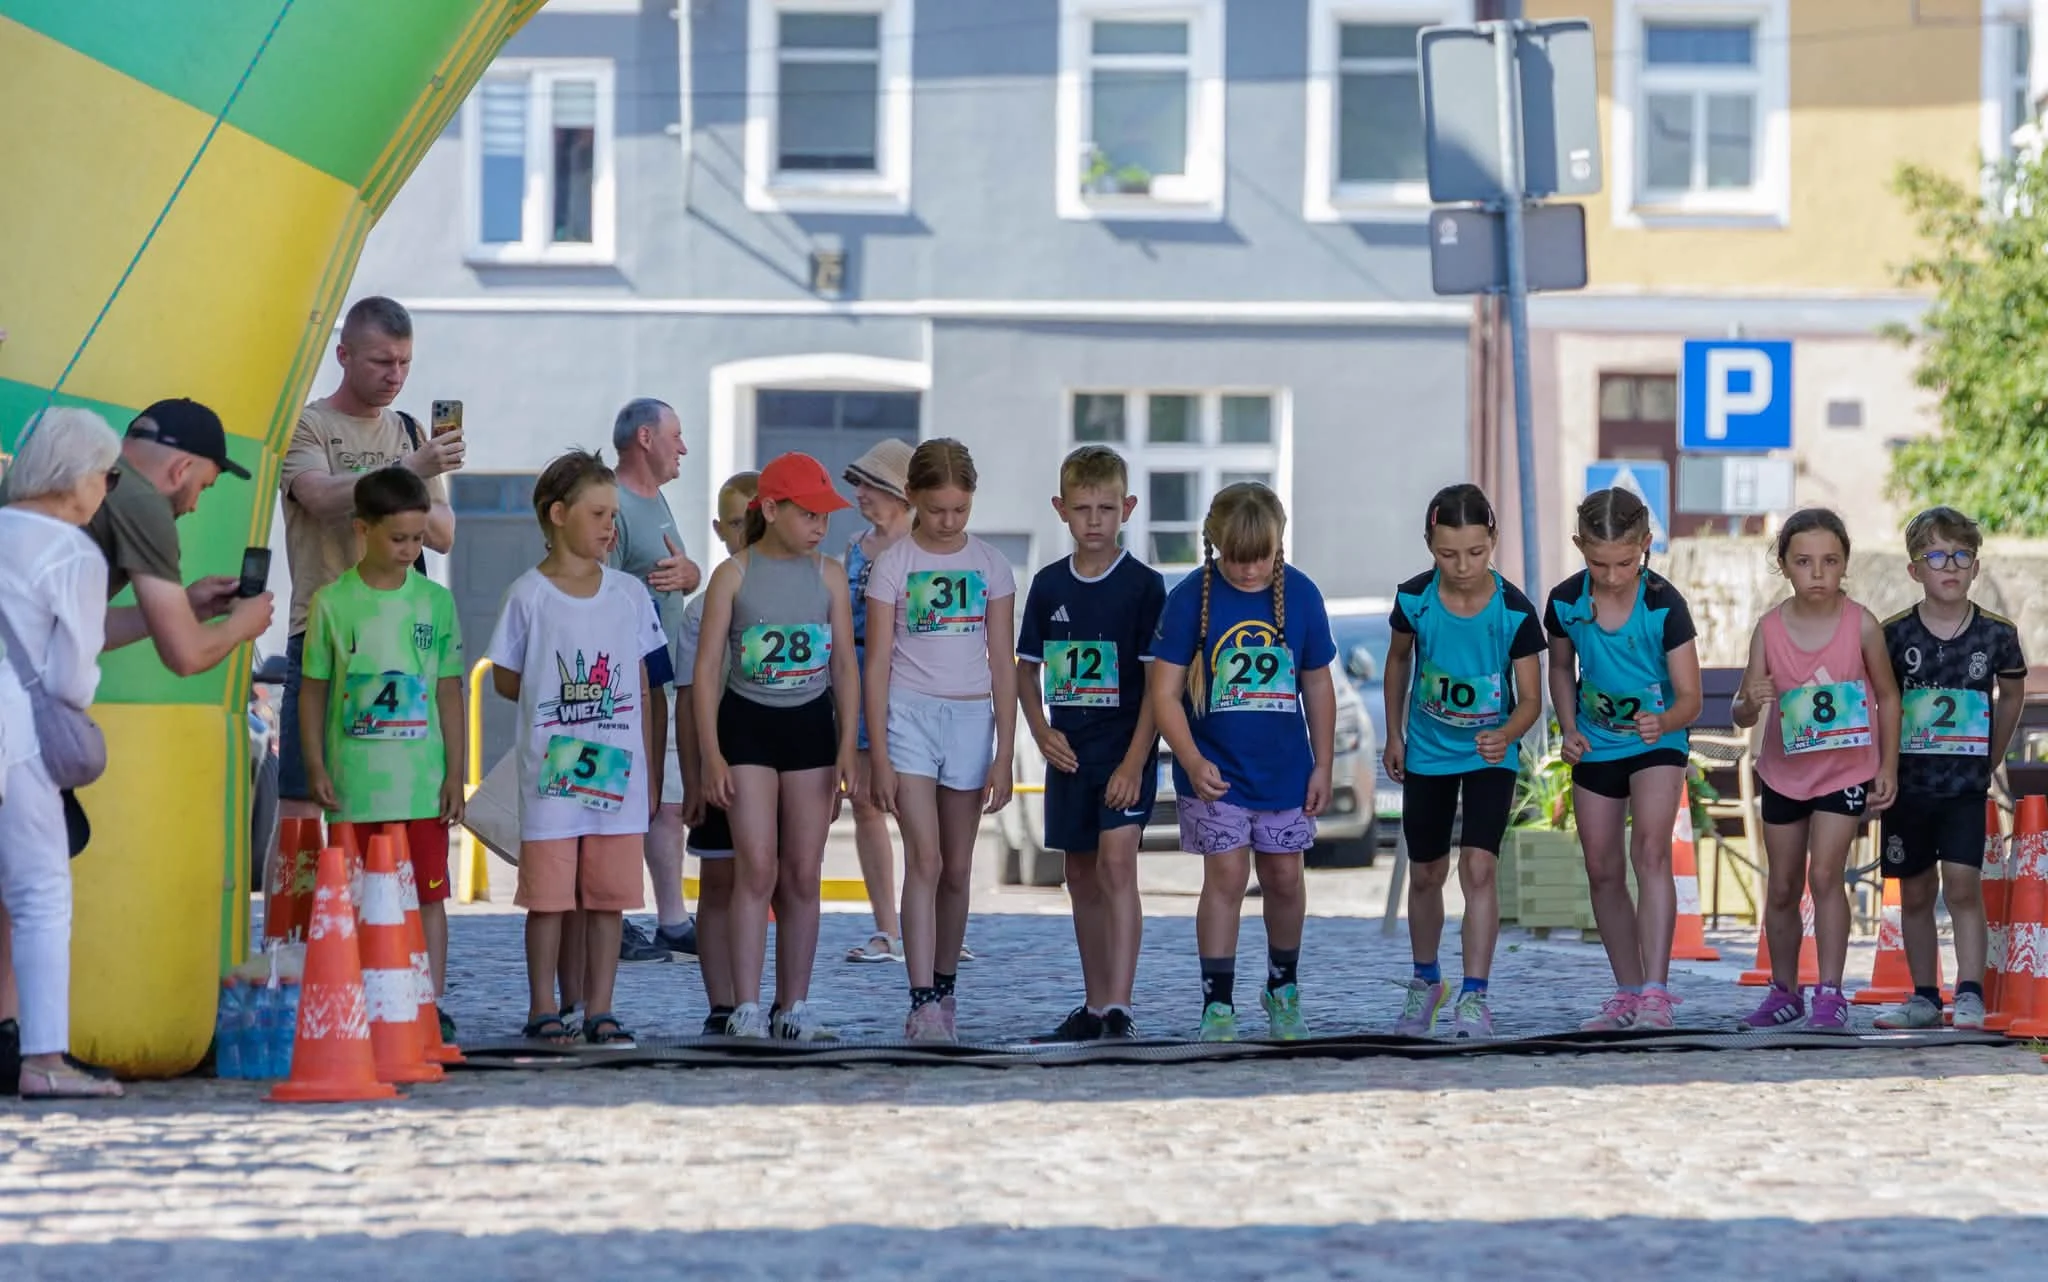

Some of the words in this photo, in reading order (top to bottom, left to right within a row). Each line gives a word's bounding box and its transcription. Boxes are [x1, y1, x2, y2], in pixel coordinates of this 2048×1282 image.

[1704, 348, 1773, 440] P
[930, 576, 967, 609] 31
[761, 630, 812, 663] 28
[1904, 646, 1922, 674] 9
[1066, 647, 1102, 680] 12
[1228, 652, 1279, 685] 29
[373, 680, 399, 712] 4
[562, 682, 603, 702] BIEG
[1439, 677, 1476, 708] 10
[1597, 692, 1642, 721] 32
[1813, 690, 1836, 723] 8
[1931, 695, 1956, 728] 2
[573, 746, 600, 779] 5
